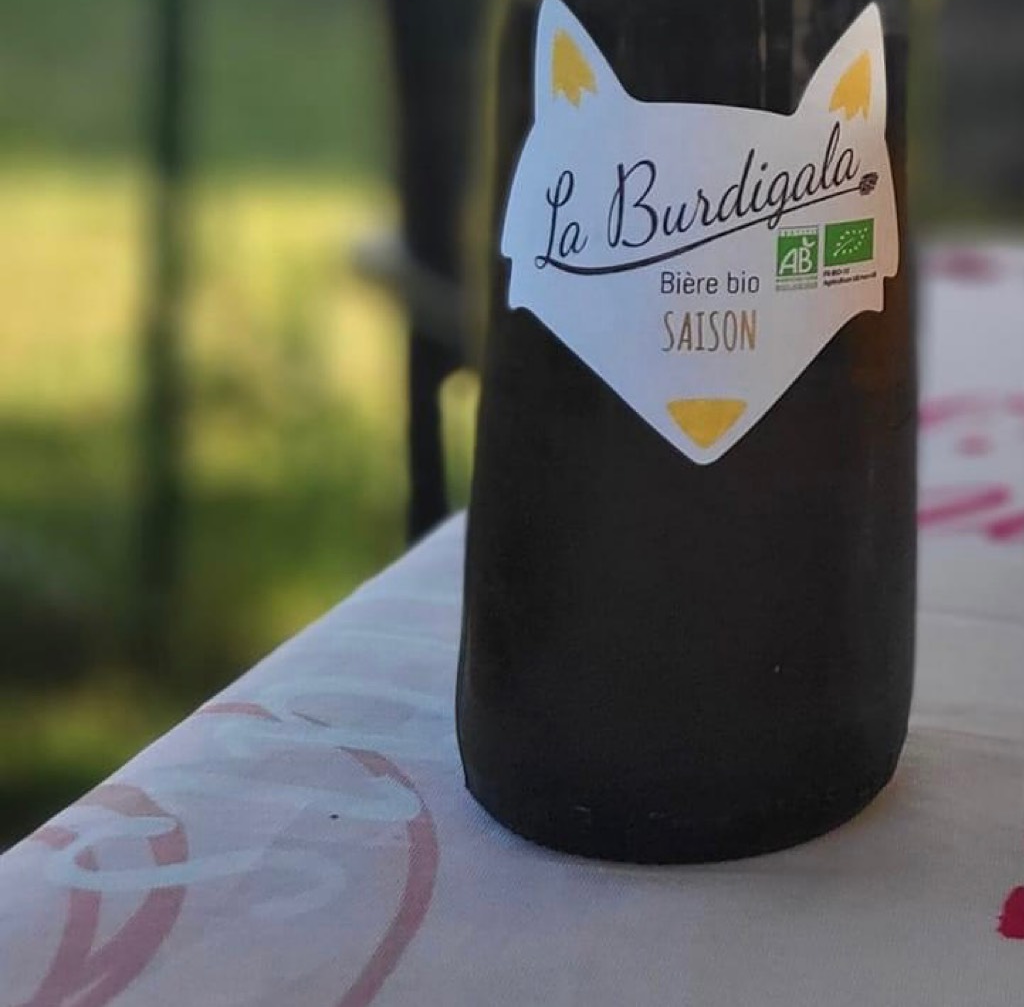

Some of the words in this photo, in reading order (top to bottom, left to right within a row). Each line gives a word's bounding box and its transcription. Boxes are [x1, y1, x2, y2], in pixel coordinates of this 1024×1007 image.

[535, 170, 588, 269] La
[607, 121, 861, 247] Burdigala
[779, 247, 813, 275] AB
[660, 271, 718, 294] Bière
[727, 270, 760, 294] bio
[661, 310, 756, 351] SAISON
